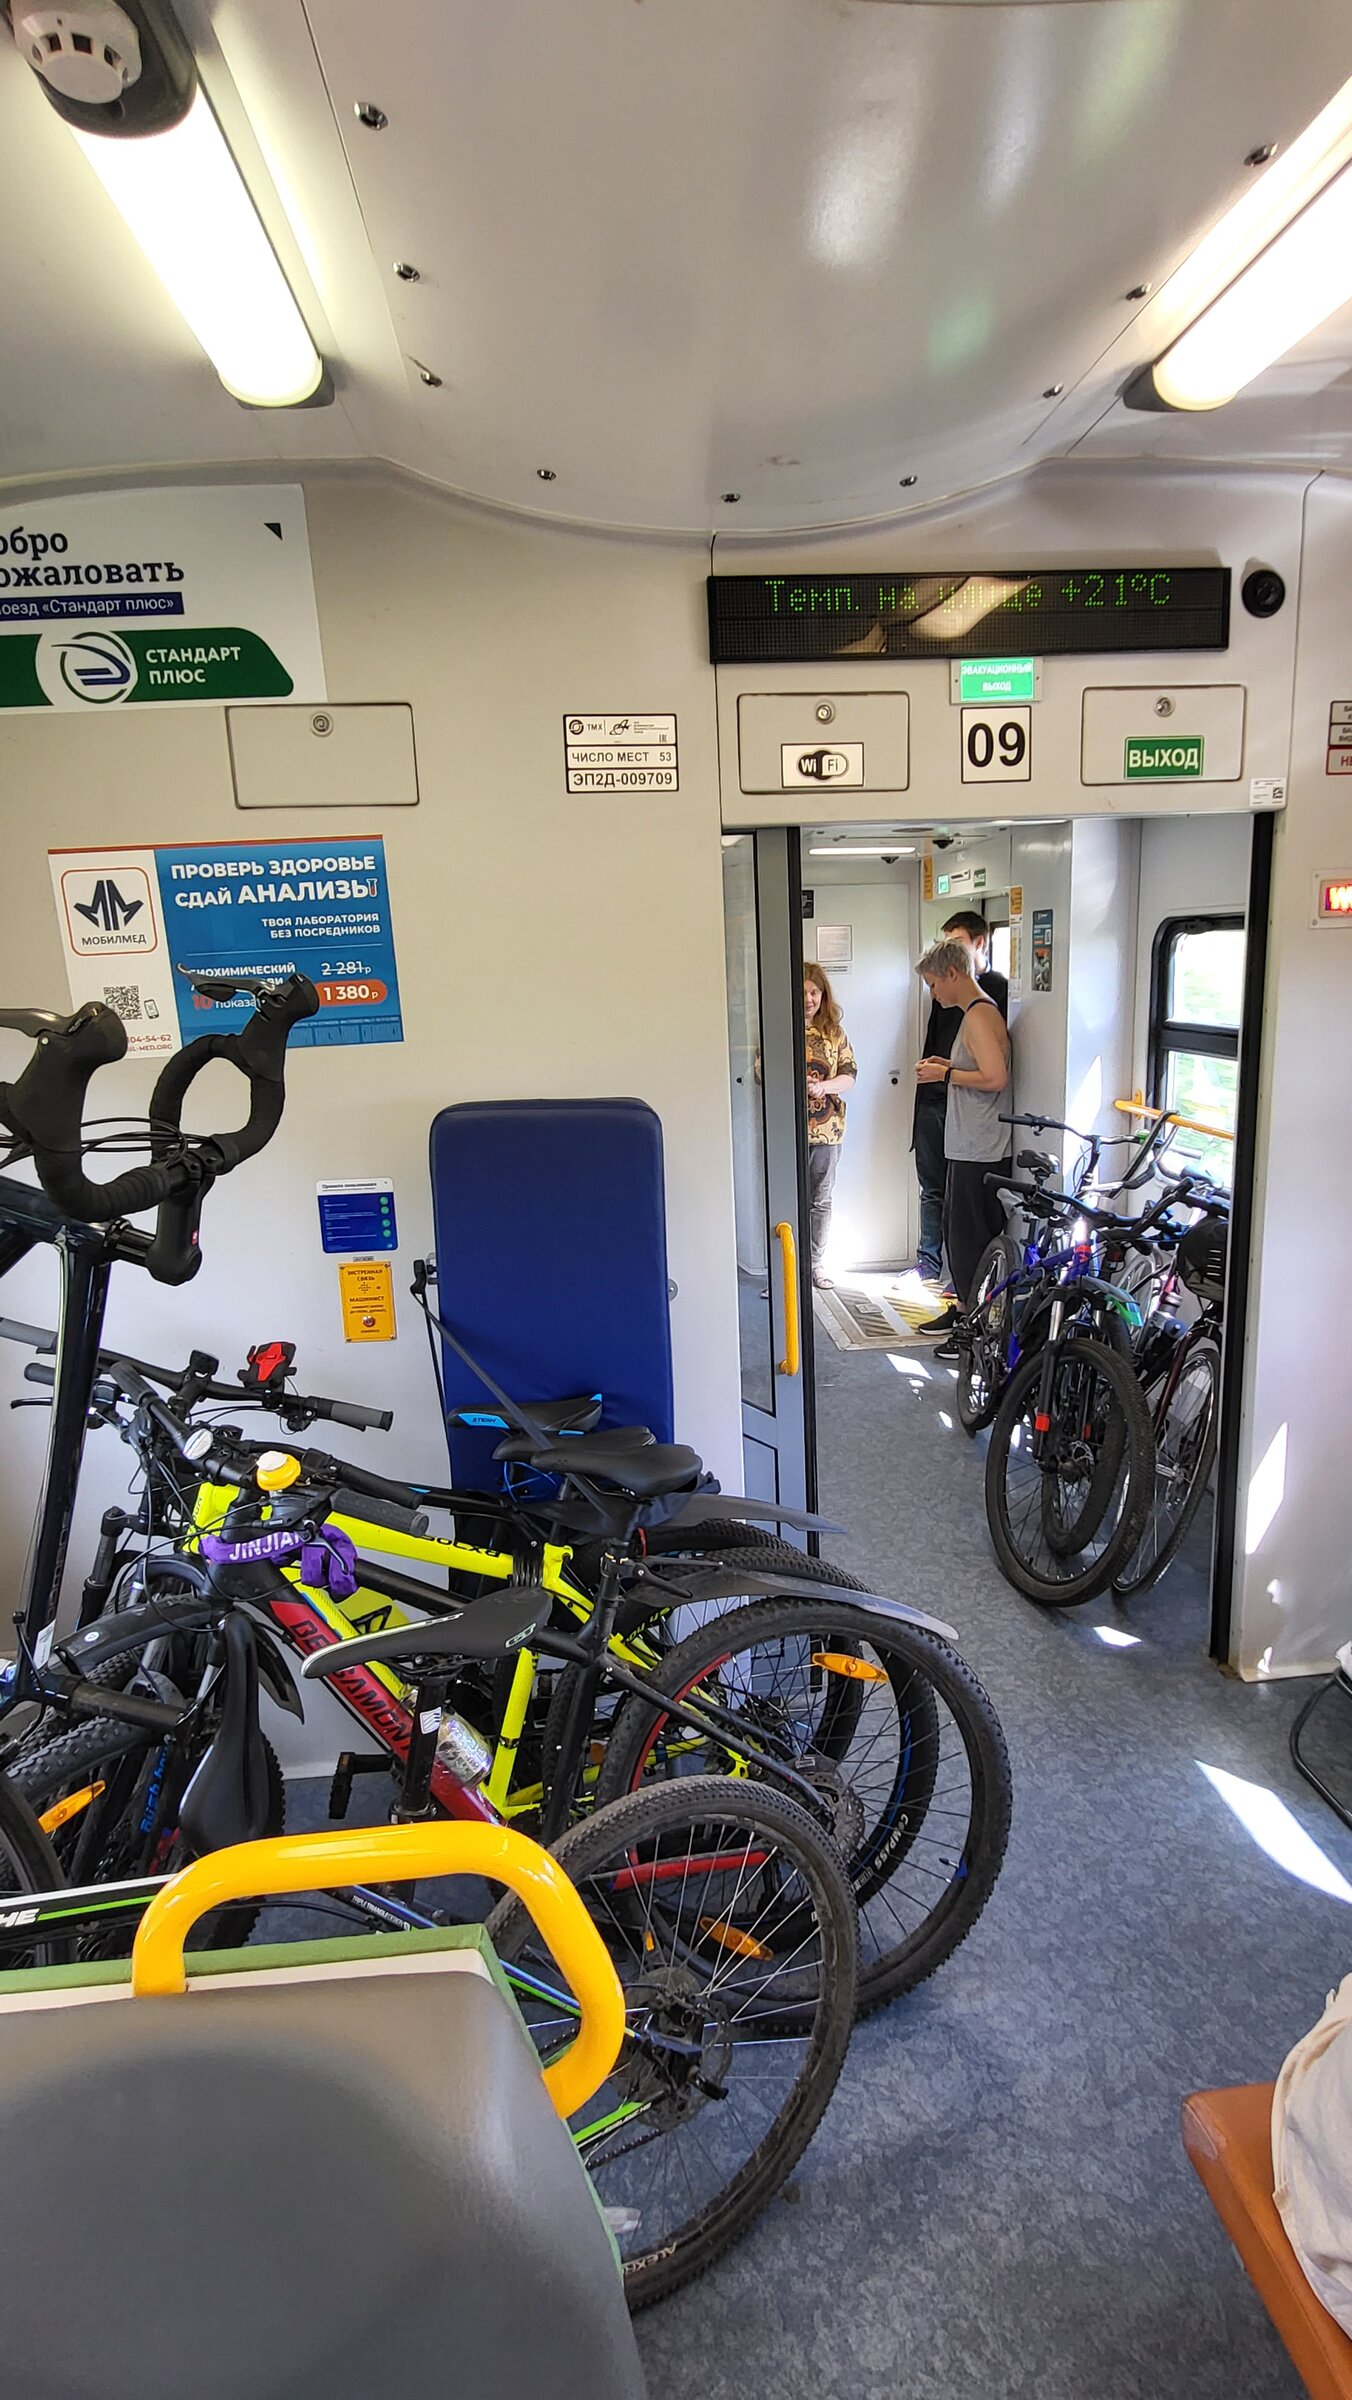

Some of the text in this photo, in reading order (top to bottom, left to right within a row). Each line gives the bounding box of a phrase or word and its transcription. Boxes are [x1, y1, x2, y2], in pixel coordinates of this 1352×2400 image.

[765, 578, 860, 612] Темп.
[879, 587, 920, 611] на
[939, 583, 1043, 613] улице
[0, 597, 174, 616] оезд «Стандарт плюс»
[146, 646, 241, 664] СТАНДАРТ
[961, 662, 1033, 675] ЭВАКУАЦИОННЫЙ
[149, 668, 206, 685] ПЛЮС
[982, 681, 1012, 692] ВЫХОД
[967, 721, 1026, 768] 09
[572, 751, 672, 763] ЧИСЛО МЕСТ 53
[1128, 747, 1199, 770] ВЫХОД
[801, 758, 839, 773] Wi Fi
[573, 773, 672, 788] ЭП2Д-009709
[171, 856, 376, 880] ПРОВЕРЬ ЗДОРОВЬЕ
[175, 887, 232, 908] СДАЙ
[261, 913, 379, 928] ТВОЯ ЛАБОРАТОРИЯ
[270, 925, 381, 939] БЕЗ ПОСРЕДНИКОВ
[81, 933, 147, 947] МОБИЛМЕД
[336, 985, 370, 1000] 380
[128, 1034, 172, 1044] 04-54-62
